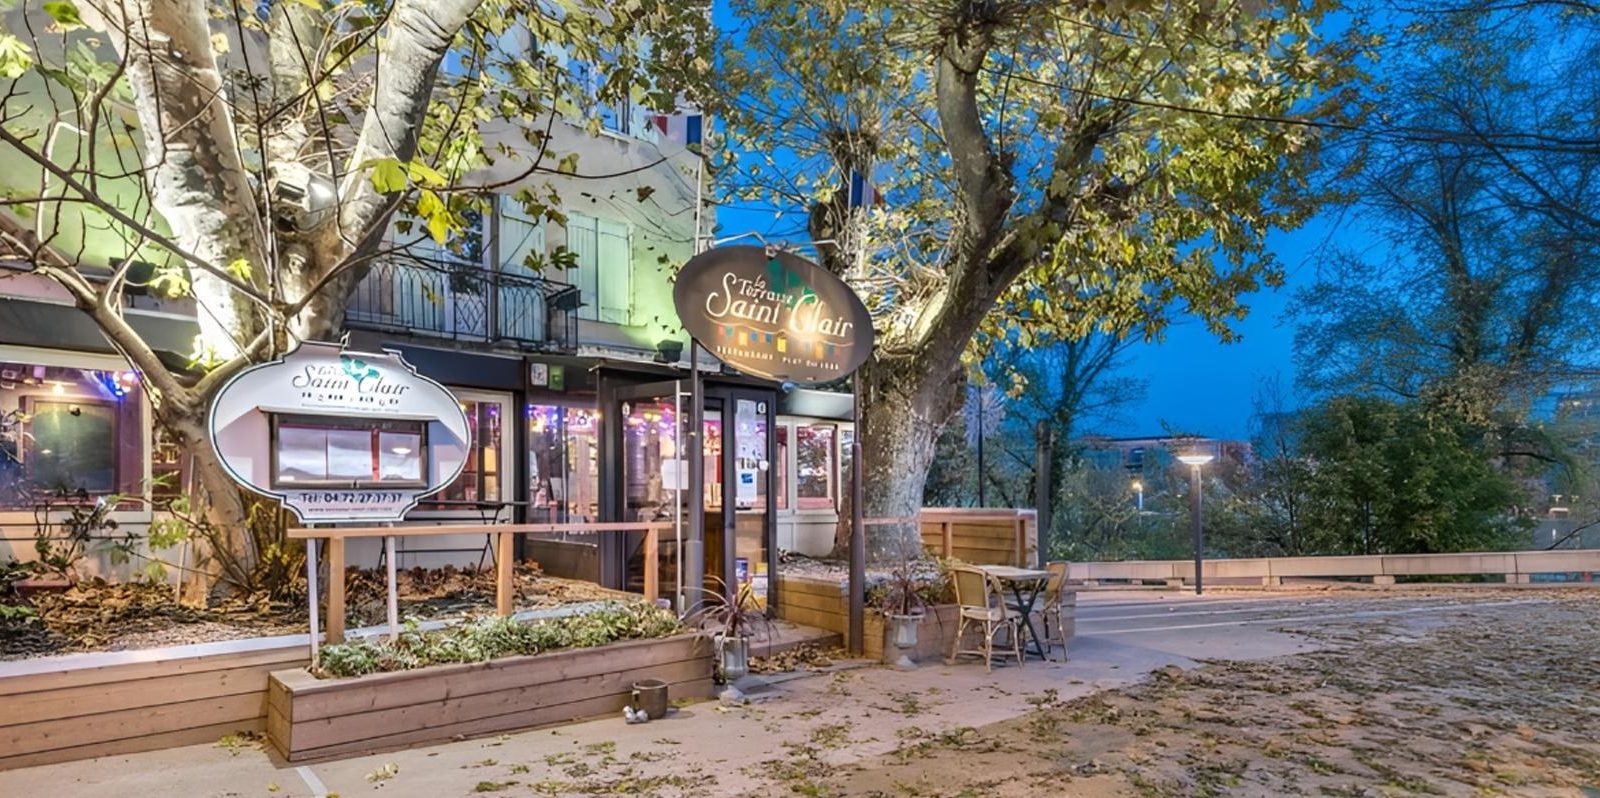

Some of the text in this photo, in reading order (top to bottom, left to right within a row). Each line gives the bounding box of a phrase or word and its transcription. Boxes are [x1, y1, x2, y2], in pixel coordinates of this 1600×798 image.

[754, 274, 767, 289] La
[706, 272, 854, 337] Saint Clair
